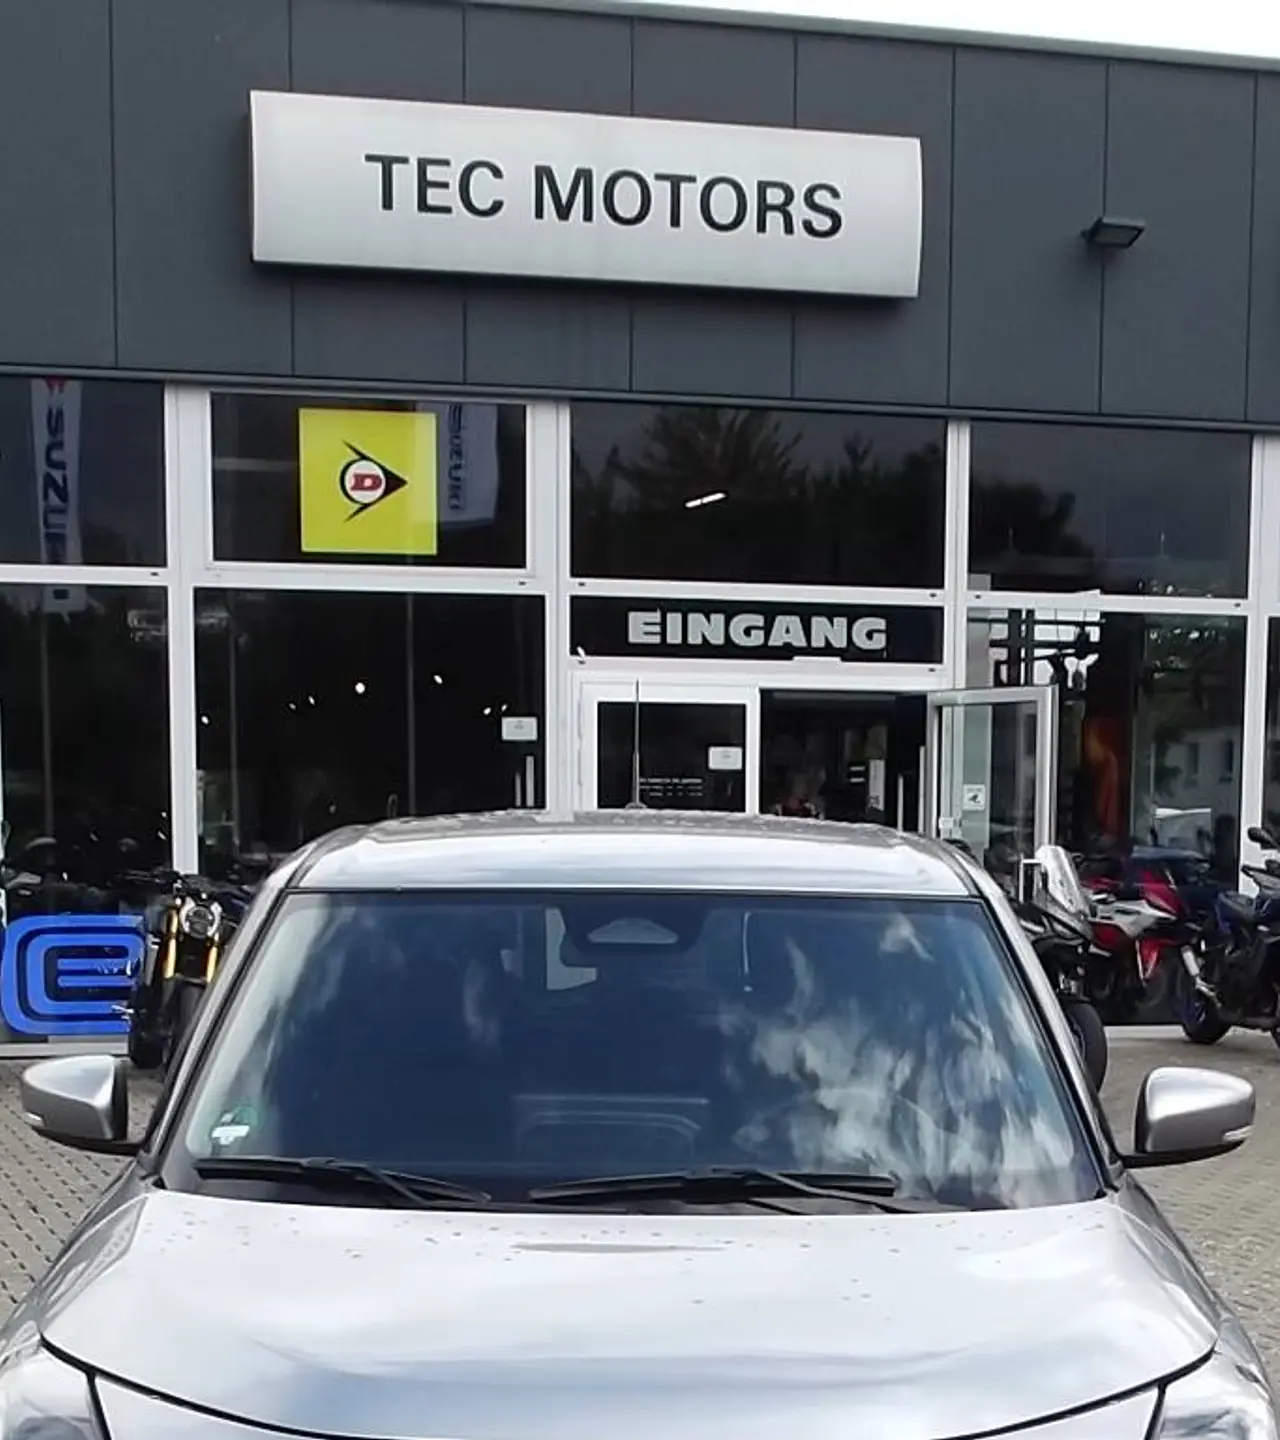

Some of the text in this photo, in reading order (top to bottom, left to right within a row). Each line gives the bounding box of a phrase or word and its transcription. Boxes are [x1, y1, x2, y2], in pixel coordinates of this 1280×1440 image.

[364, 152, 844, 240] TEC MOTORS
[627, 610, 888, 651] EINGANG
